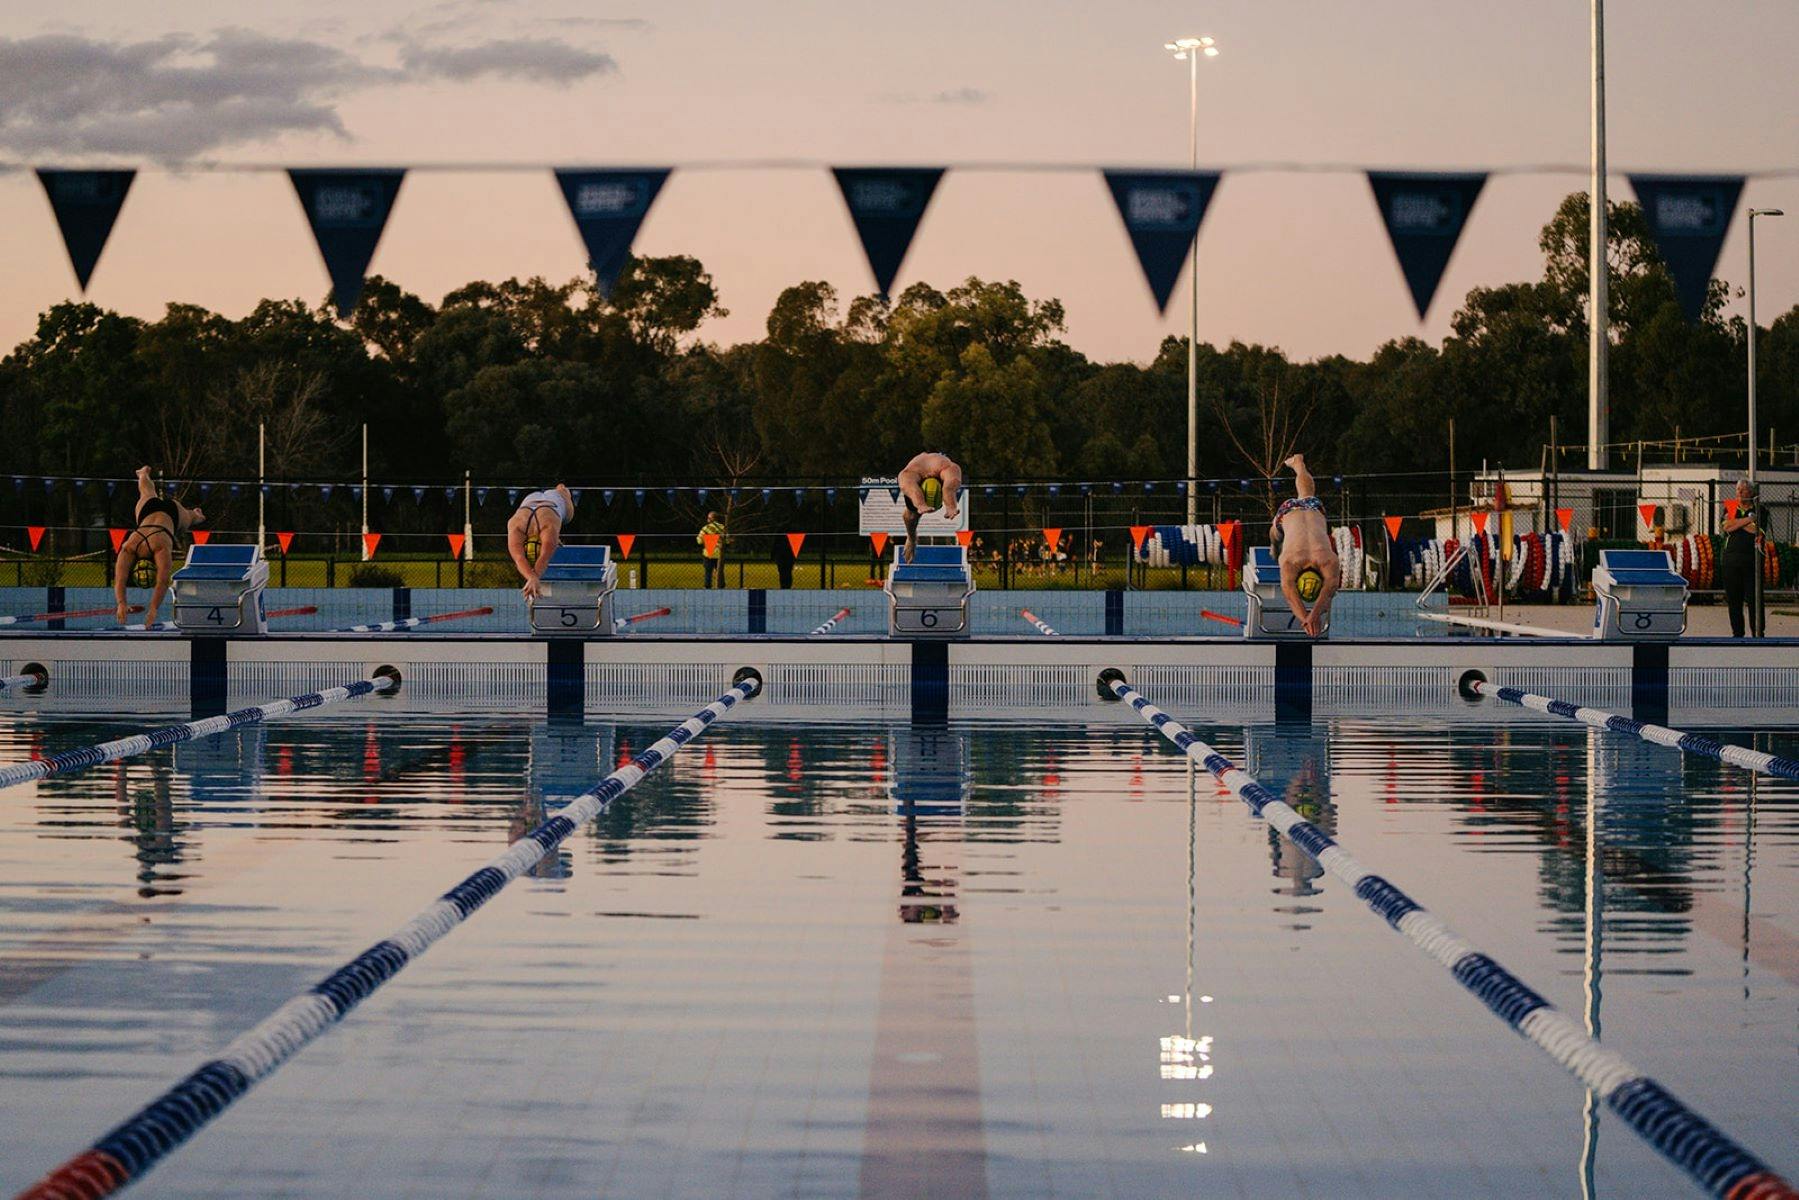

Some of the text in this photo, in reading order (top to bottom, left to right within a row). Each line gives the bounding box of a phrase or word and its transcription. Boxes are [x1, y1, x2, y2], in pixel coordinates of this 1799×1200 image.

[862, 477, 898, 485] 50m Pool
[207, 606, 224, 625] 4
[561, 607, 577, 626] 5
[921, 608, 937, 627] 6
[1635, 610, 1651, 629] 8
